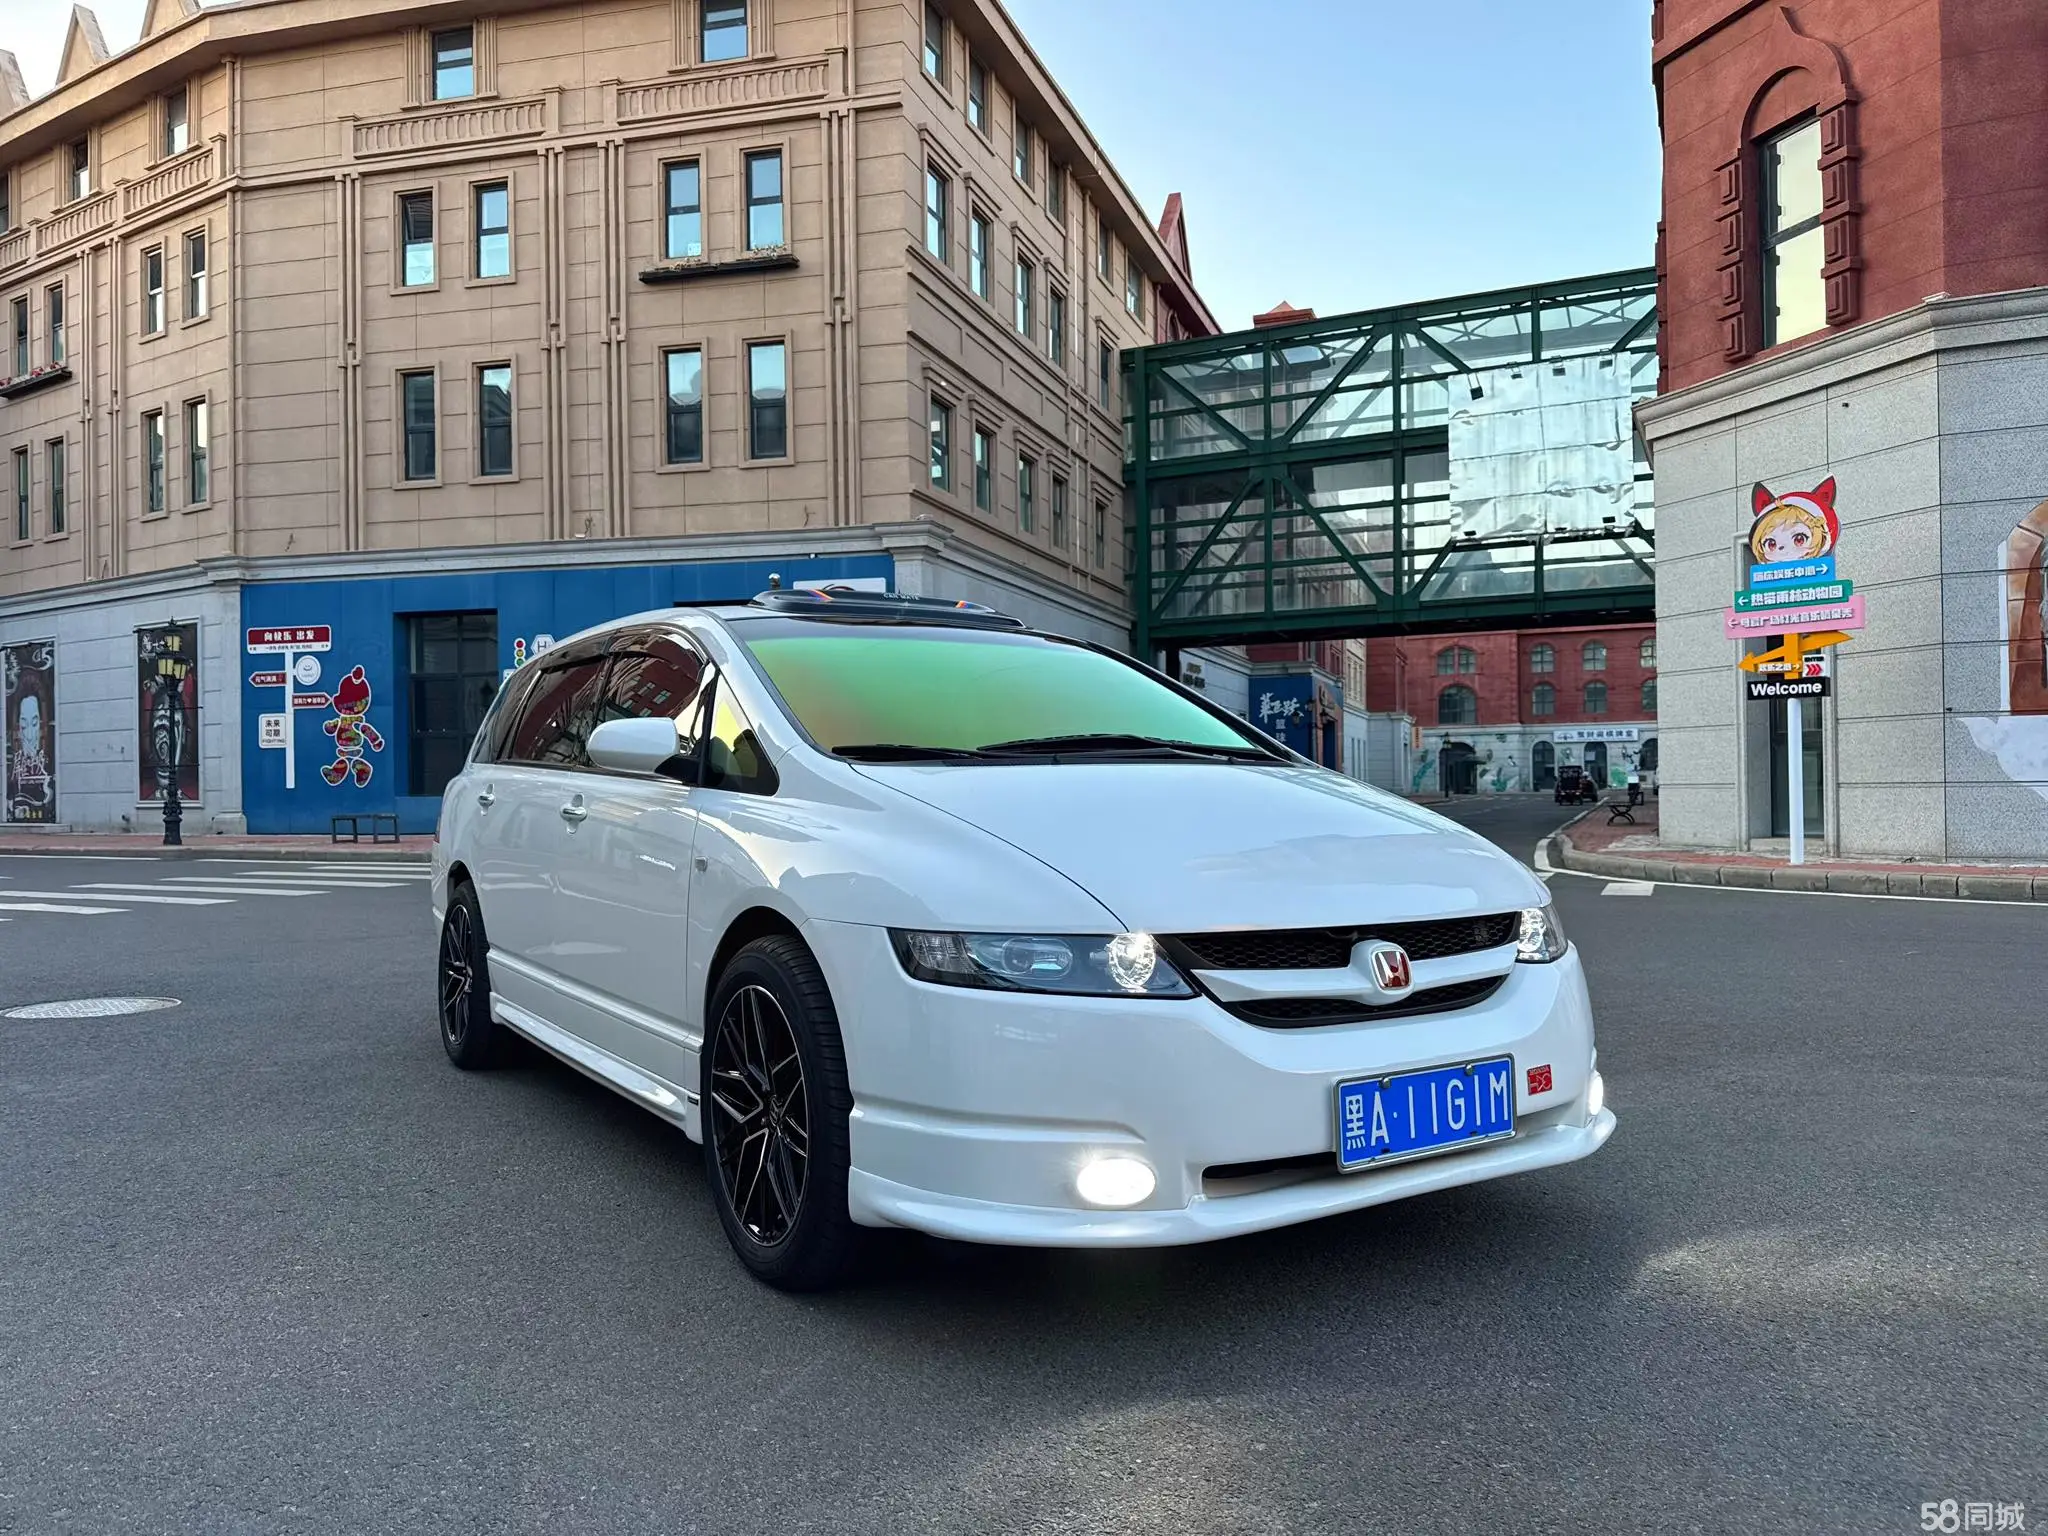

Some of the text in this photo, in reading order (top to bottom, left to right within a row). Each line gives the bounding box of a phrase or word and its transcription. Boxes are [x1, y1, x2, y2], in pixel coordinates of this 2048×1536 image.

[1751, 585, 1843, 606] 热带雨林动物园
[1750, 682, 1822, 697] Welcome
